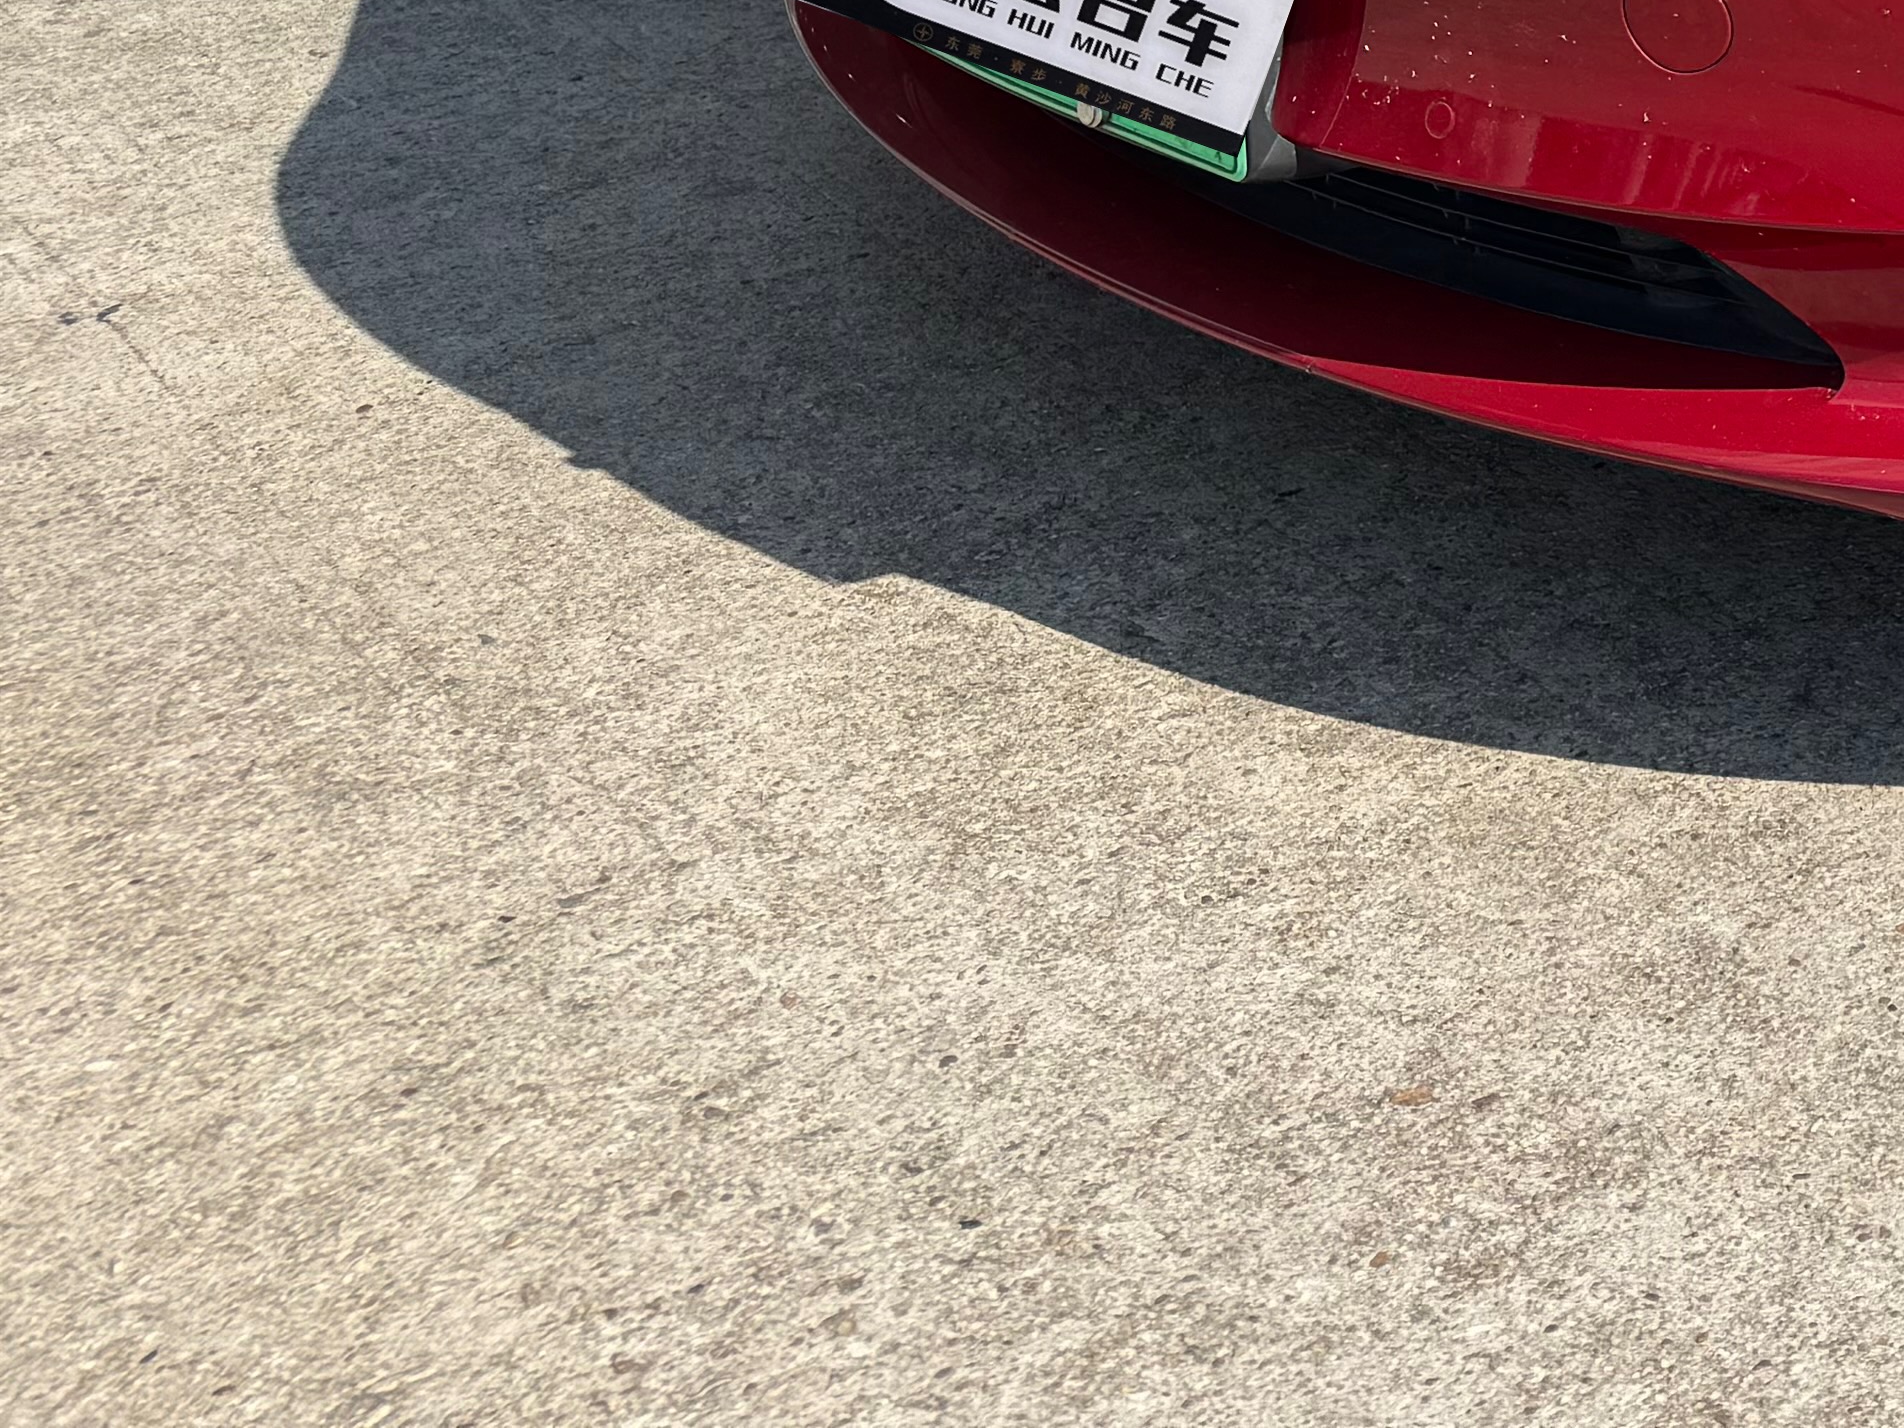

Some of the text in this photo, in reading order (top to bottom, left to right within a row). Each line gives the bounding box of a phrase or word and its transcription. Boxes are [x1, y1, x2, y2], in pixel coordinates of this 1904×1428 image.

[1007, 8, 1055, 40] HUI
[1070, 32, 1140, 72] MING
[1156, 63, 1215, 99] CHE
